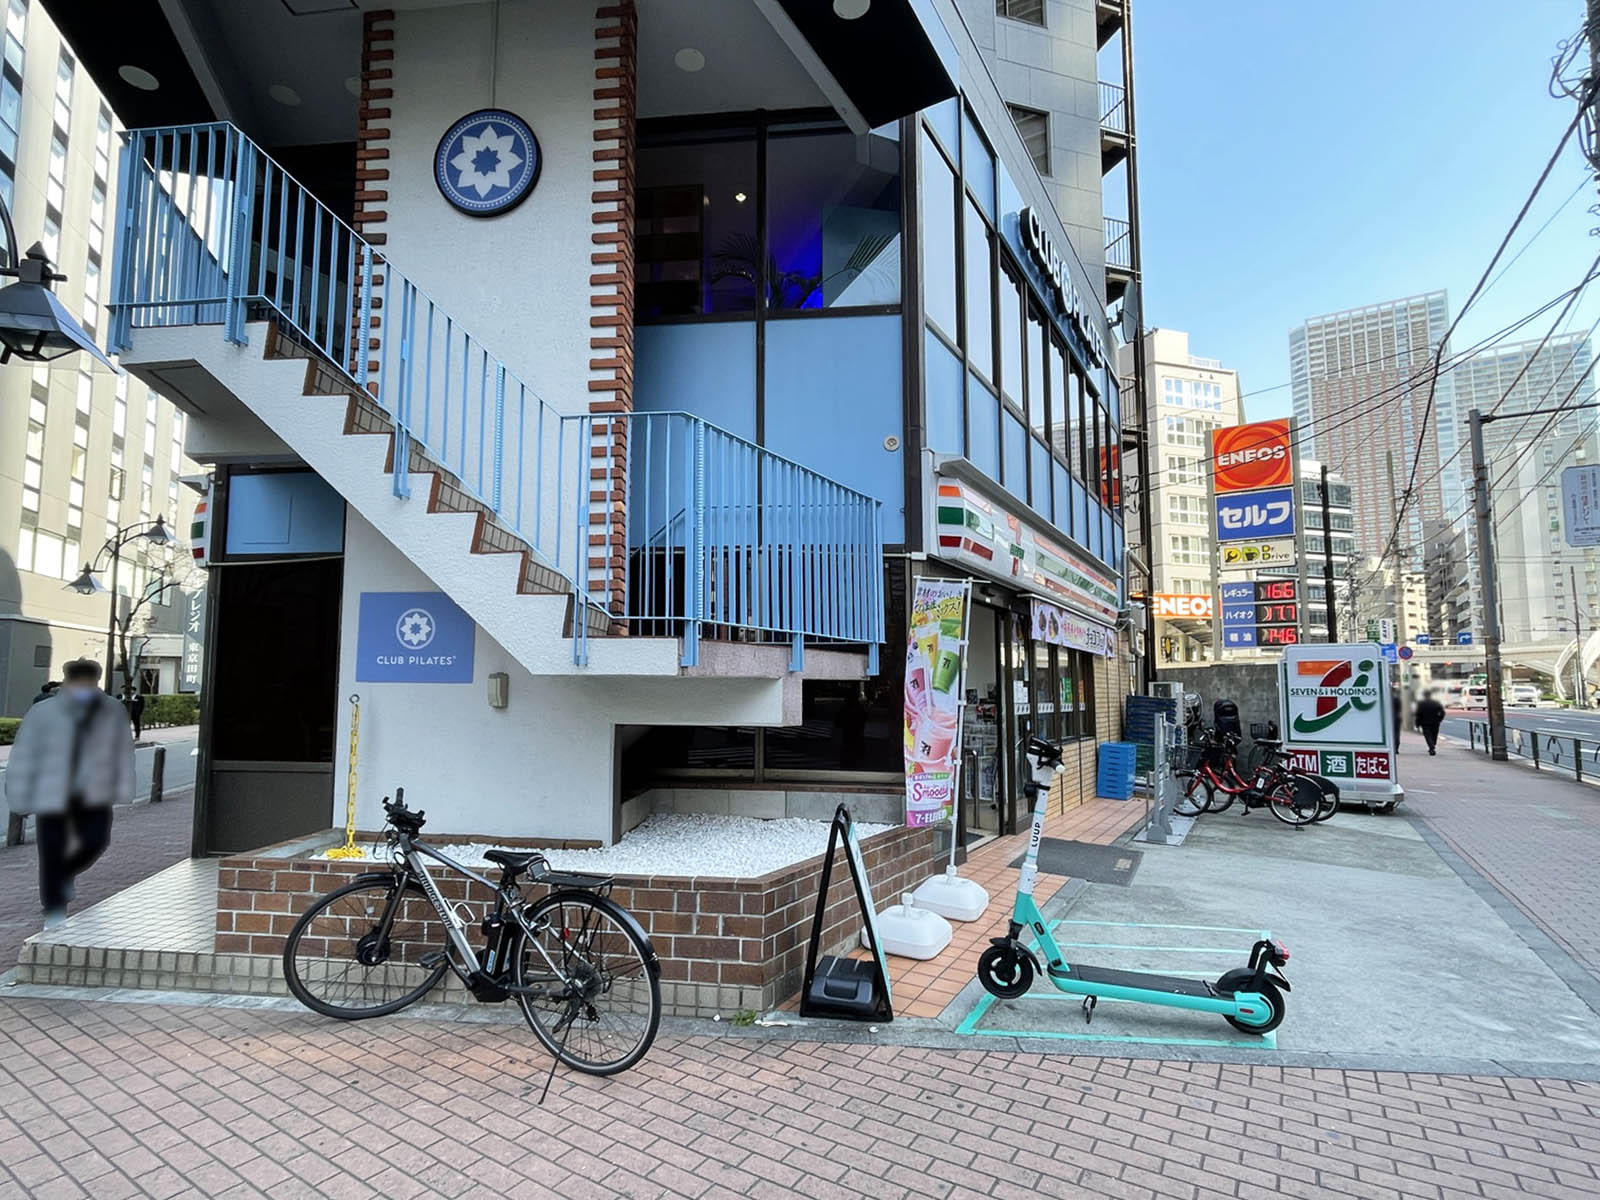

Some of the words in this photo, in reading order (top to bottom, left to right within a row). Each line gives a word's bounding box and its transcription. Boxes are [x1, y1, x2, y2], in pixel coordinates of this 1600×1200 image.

[1217, 445, 1286, 467] ENEOS
[1219, 501, 1290, 529] セルフ
[1224, 588, 1253, 598] レギュラー
[1225, 610, 1254, 620] ハイオク
[186, 642, 199, 684] 東京田町
[376, 656, 404, 665] CLUB
[408, 656, 453, 665] PILATES
[1330, 687, 1377, 696] HOLDINGS
[1288, 754, 1318, 772] ATM
[1326, 754, 1347, 773] 酒
[1356, 757, 1389, 774] たばこ
[1031, 822, 1041, 848] LUUP
